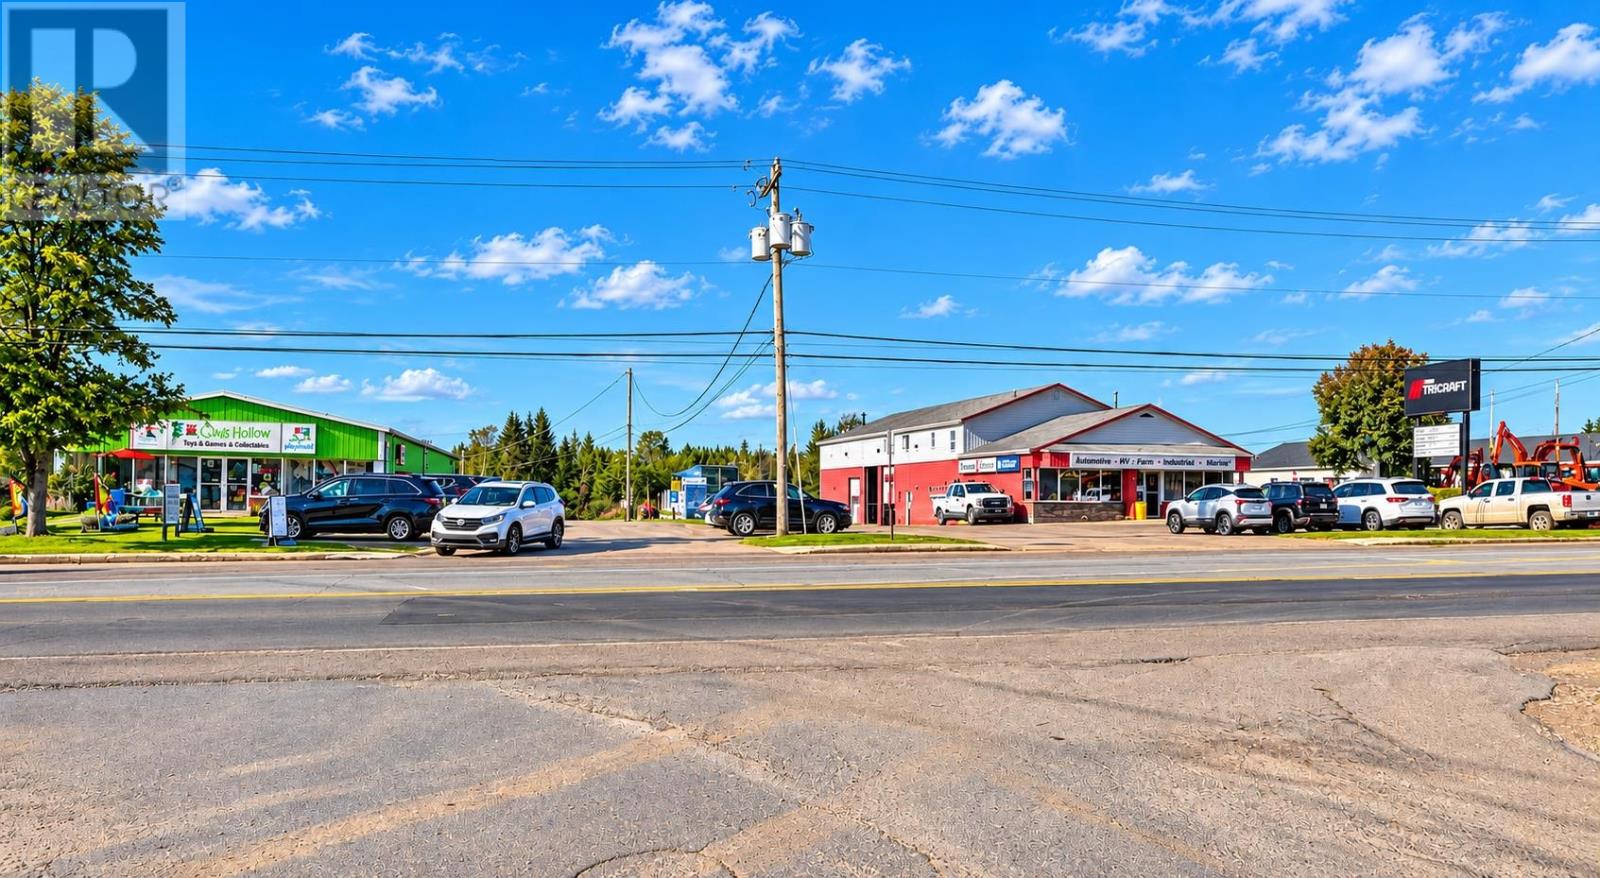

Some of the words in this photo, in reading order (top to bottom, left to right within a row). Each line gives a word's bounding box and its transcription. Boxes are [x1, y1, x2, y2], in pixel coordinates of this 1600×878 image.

[1422, 380, 1467, 395] TRICRAFT
[232, 426, 271, 439] Hollow
[204, 440, 227, 448] Games
[1075, 456, 1112, 465] Automotive
[1136, 457, 1155, 465] Farm
[1162, 458, 1195, 466] Industrial
